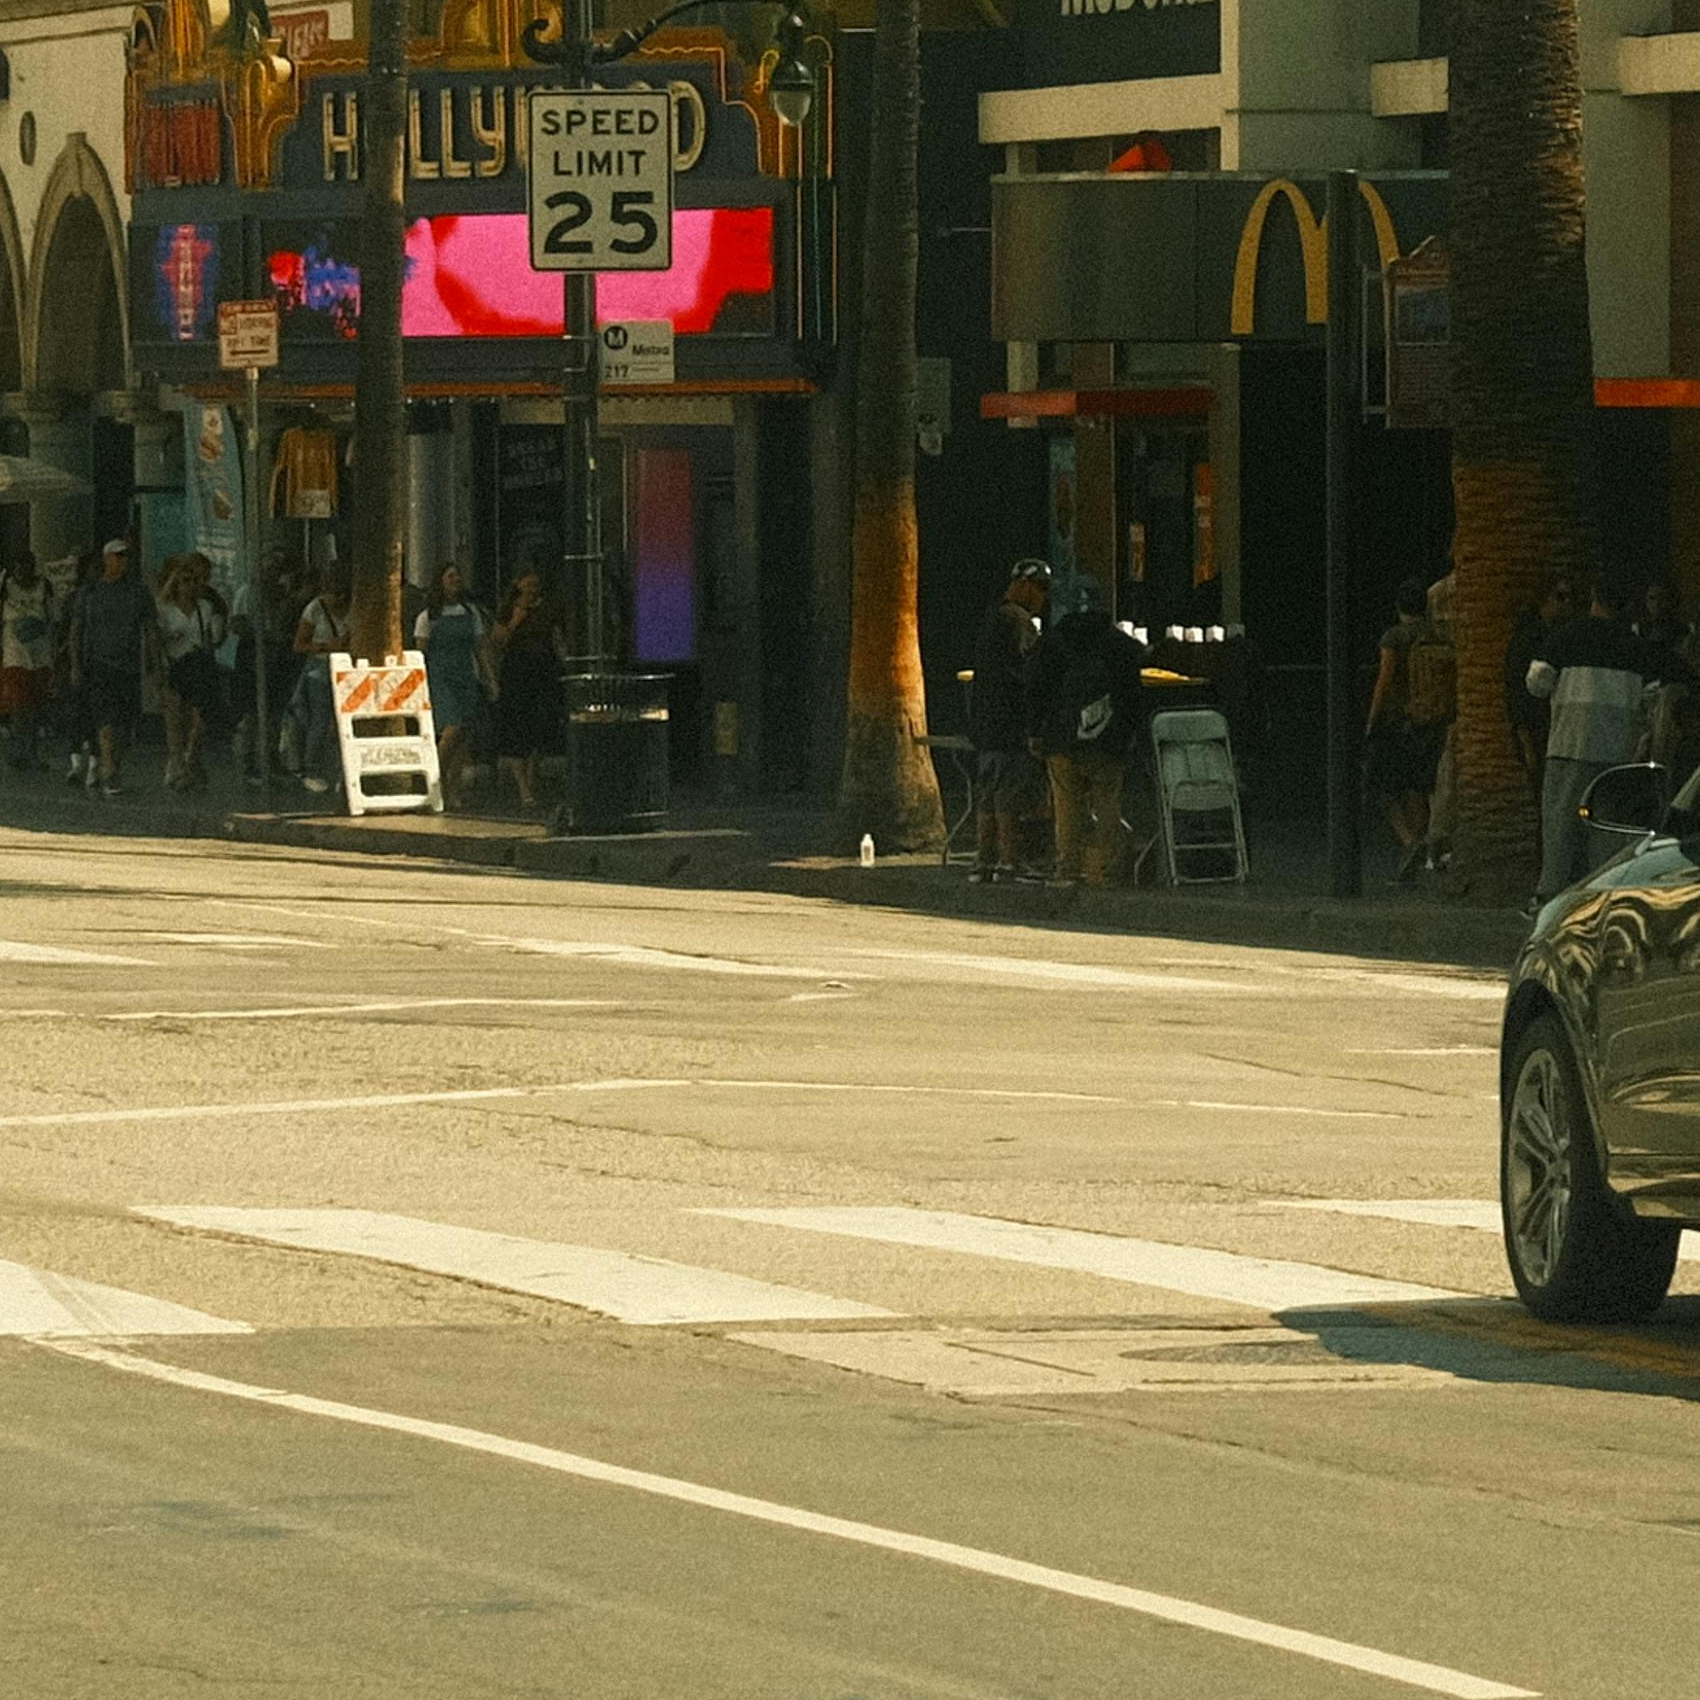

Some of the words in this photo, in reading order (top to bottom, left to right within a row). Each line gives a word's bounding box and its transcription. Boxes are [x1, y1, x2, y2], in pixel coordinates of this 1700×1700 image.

[541, 110, 659, 136] SPEED
[553, 150, 647, 177] LIMIT
[544, 191, 659, 254] 25
[632, 343, 670, 356] Metro
